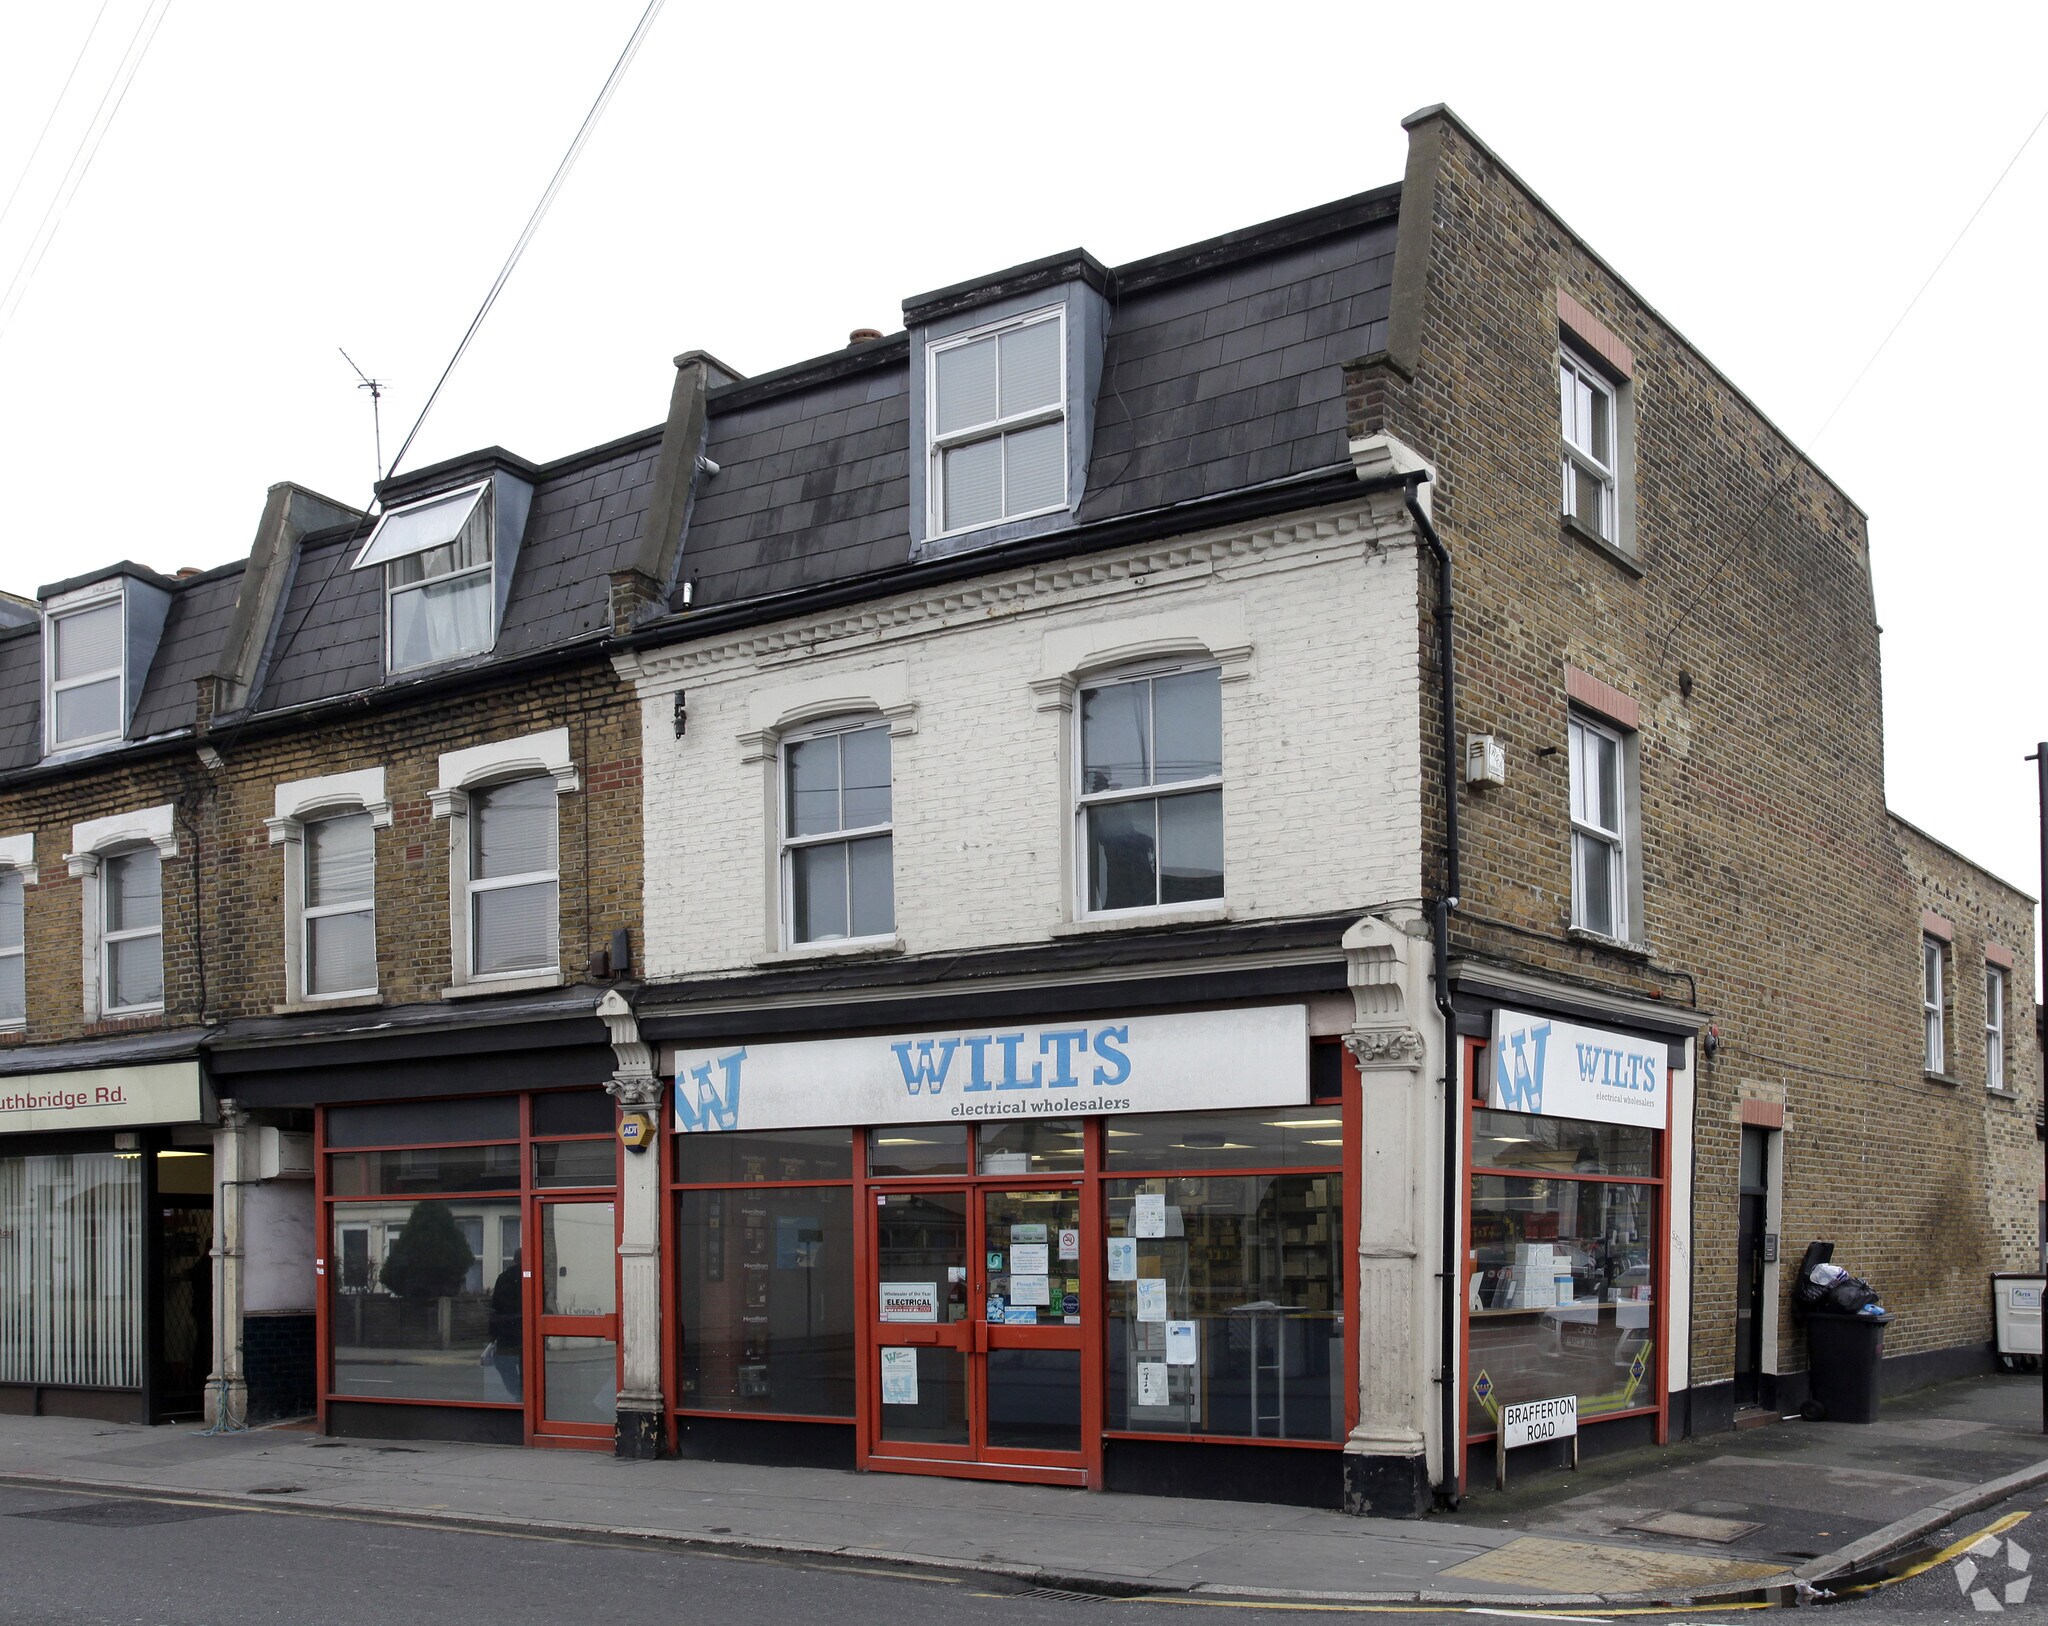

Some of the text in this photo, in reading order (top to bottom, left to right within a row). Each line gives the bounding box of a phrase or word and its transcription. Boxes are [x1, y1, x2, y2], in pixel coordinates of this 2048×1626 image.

[891, 1025, 1131, 1096] WILTS
[1575, 1042, 1656, 1093] WILTS
[95, 1086, 127, 1103] Rd.
[1595, 1091, 1655, 1108] electrical wholesalers
[951, 1097, 1130, 1116] electrical wholesalers
[624, 1125, 638, 1135] ADT
[1507, 1398, 1575, 1426] BRAFFERTON
[1527, 1421, 1555, 1441] ROAD
